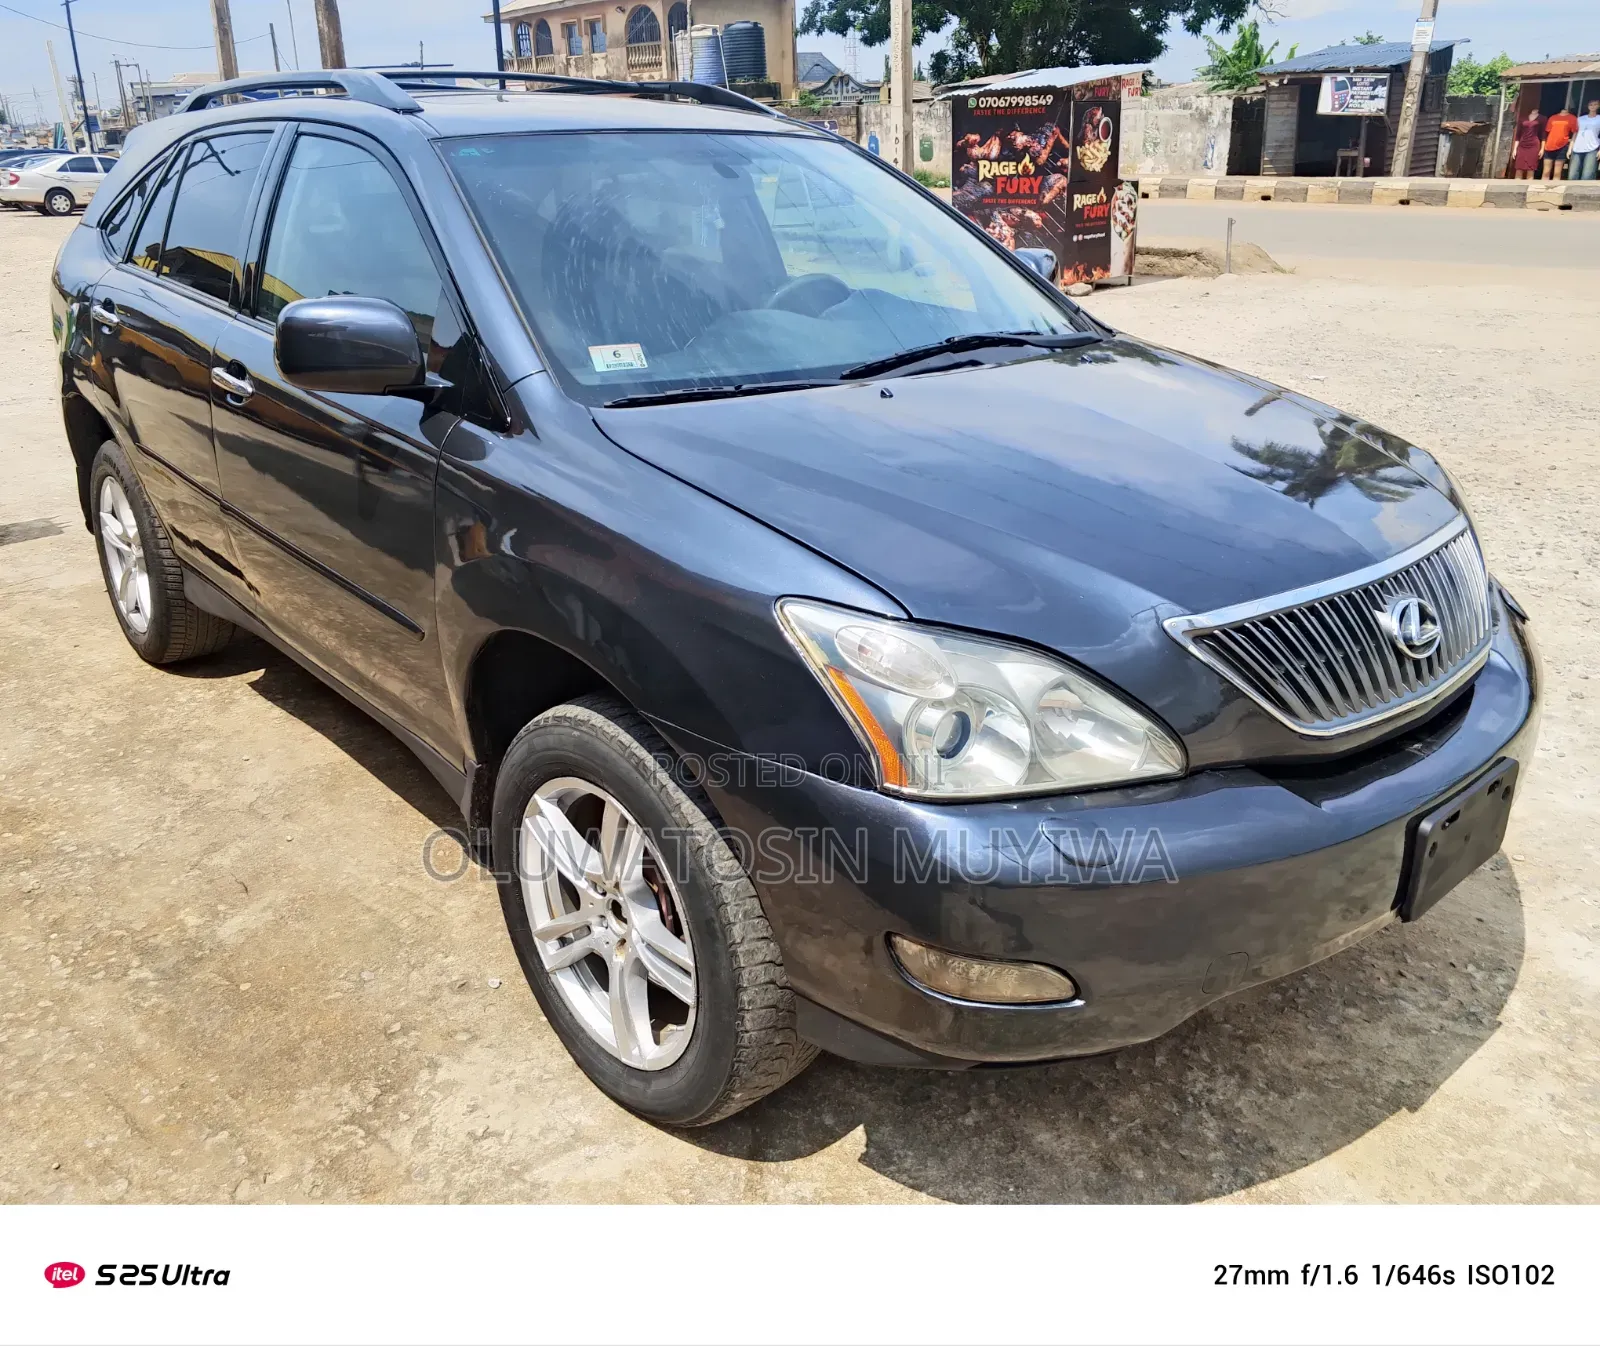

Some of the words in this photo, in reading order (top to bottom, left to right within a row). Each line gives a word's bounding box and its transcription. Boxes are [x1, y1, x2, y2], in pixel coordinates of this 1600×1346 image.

[979, 95, 1053, 108] 07067998549
[1006, 107, 1046, 115] DIFFERENCE
[978, 160, 1017, 182] RAGE
[996, 176, 1043, 194] FURY
[1073, 193, 1097, 212] RAGE
[1083, 203, 1111, 220] FURY
[613, 350, 621, 359] 6
